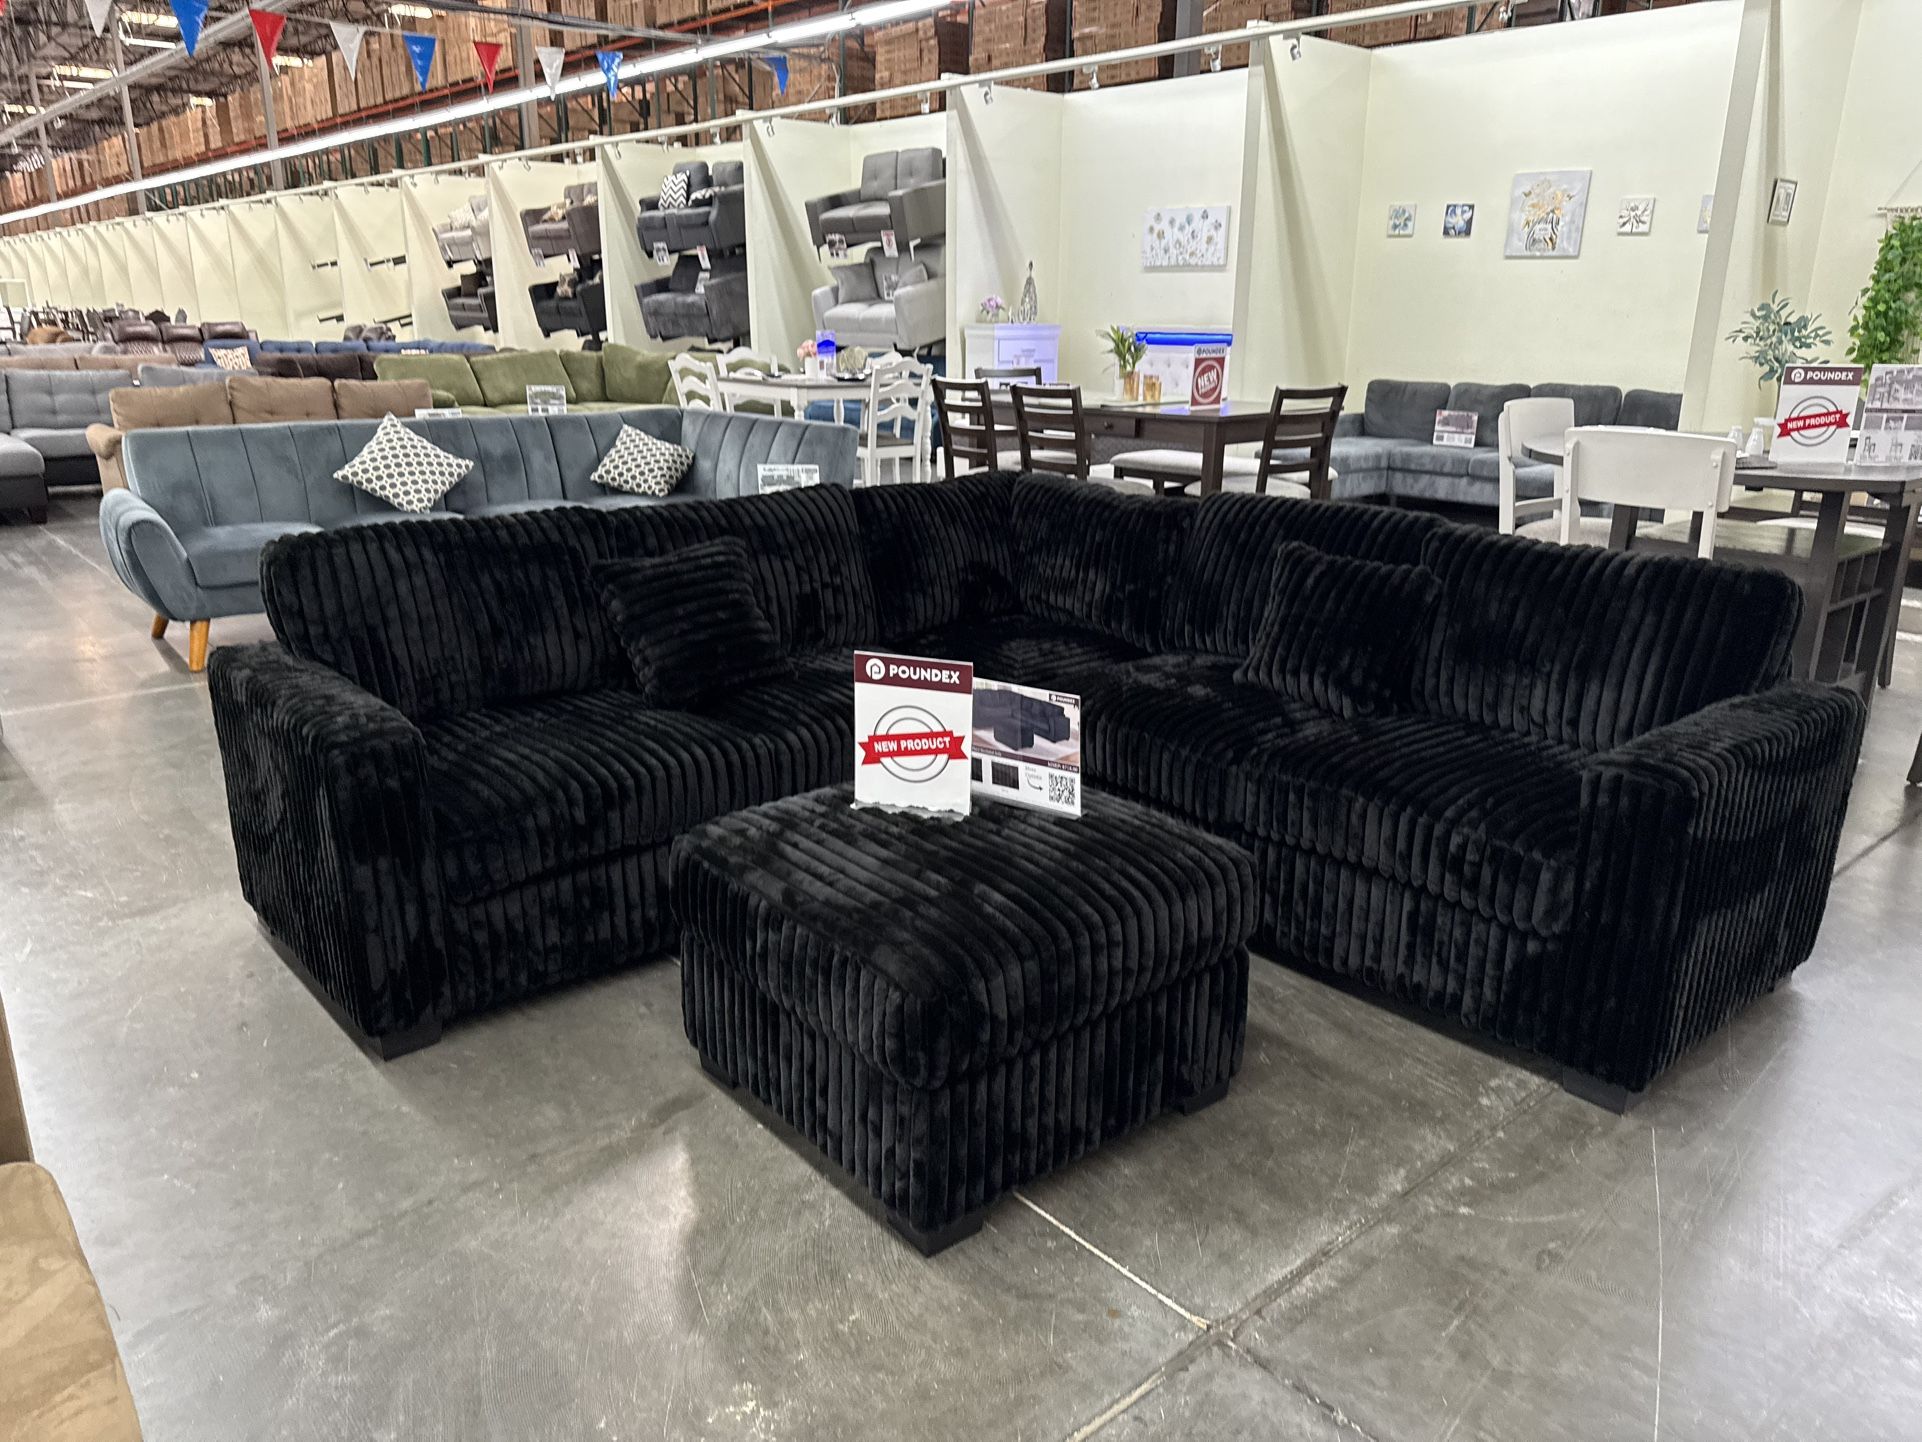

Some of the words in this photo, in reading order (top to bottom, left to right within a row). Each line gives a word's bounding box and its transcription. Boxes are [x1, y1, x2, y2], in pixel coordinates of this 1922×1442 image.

[1198, 367, 1218, 395] NEW
[1806, 371, 1854, 380] POUNDEX
[1787, 419, 1804, 430] NEW
[1805, 414, 1841, 427] PRODUCT
[889, 664, 960, 685] POUNDEX
[874, 740, 898, 753] NEW
[901, 737, 951, 752] PRODUCT
